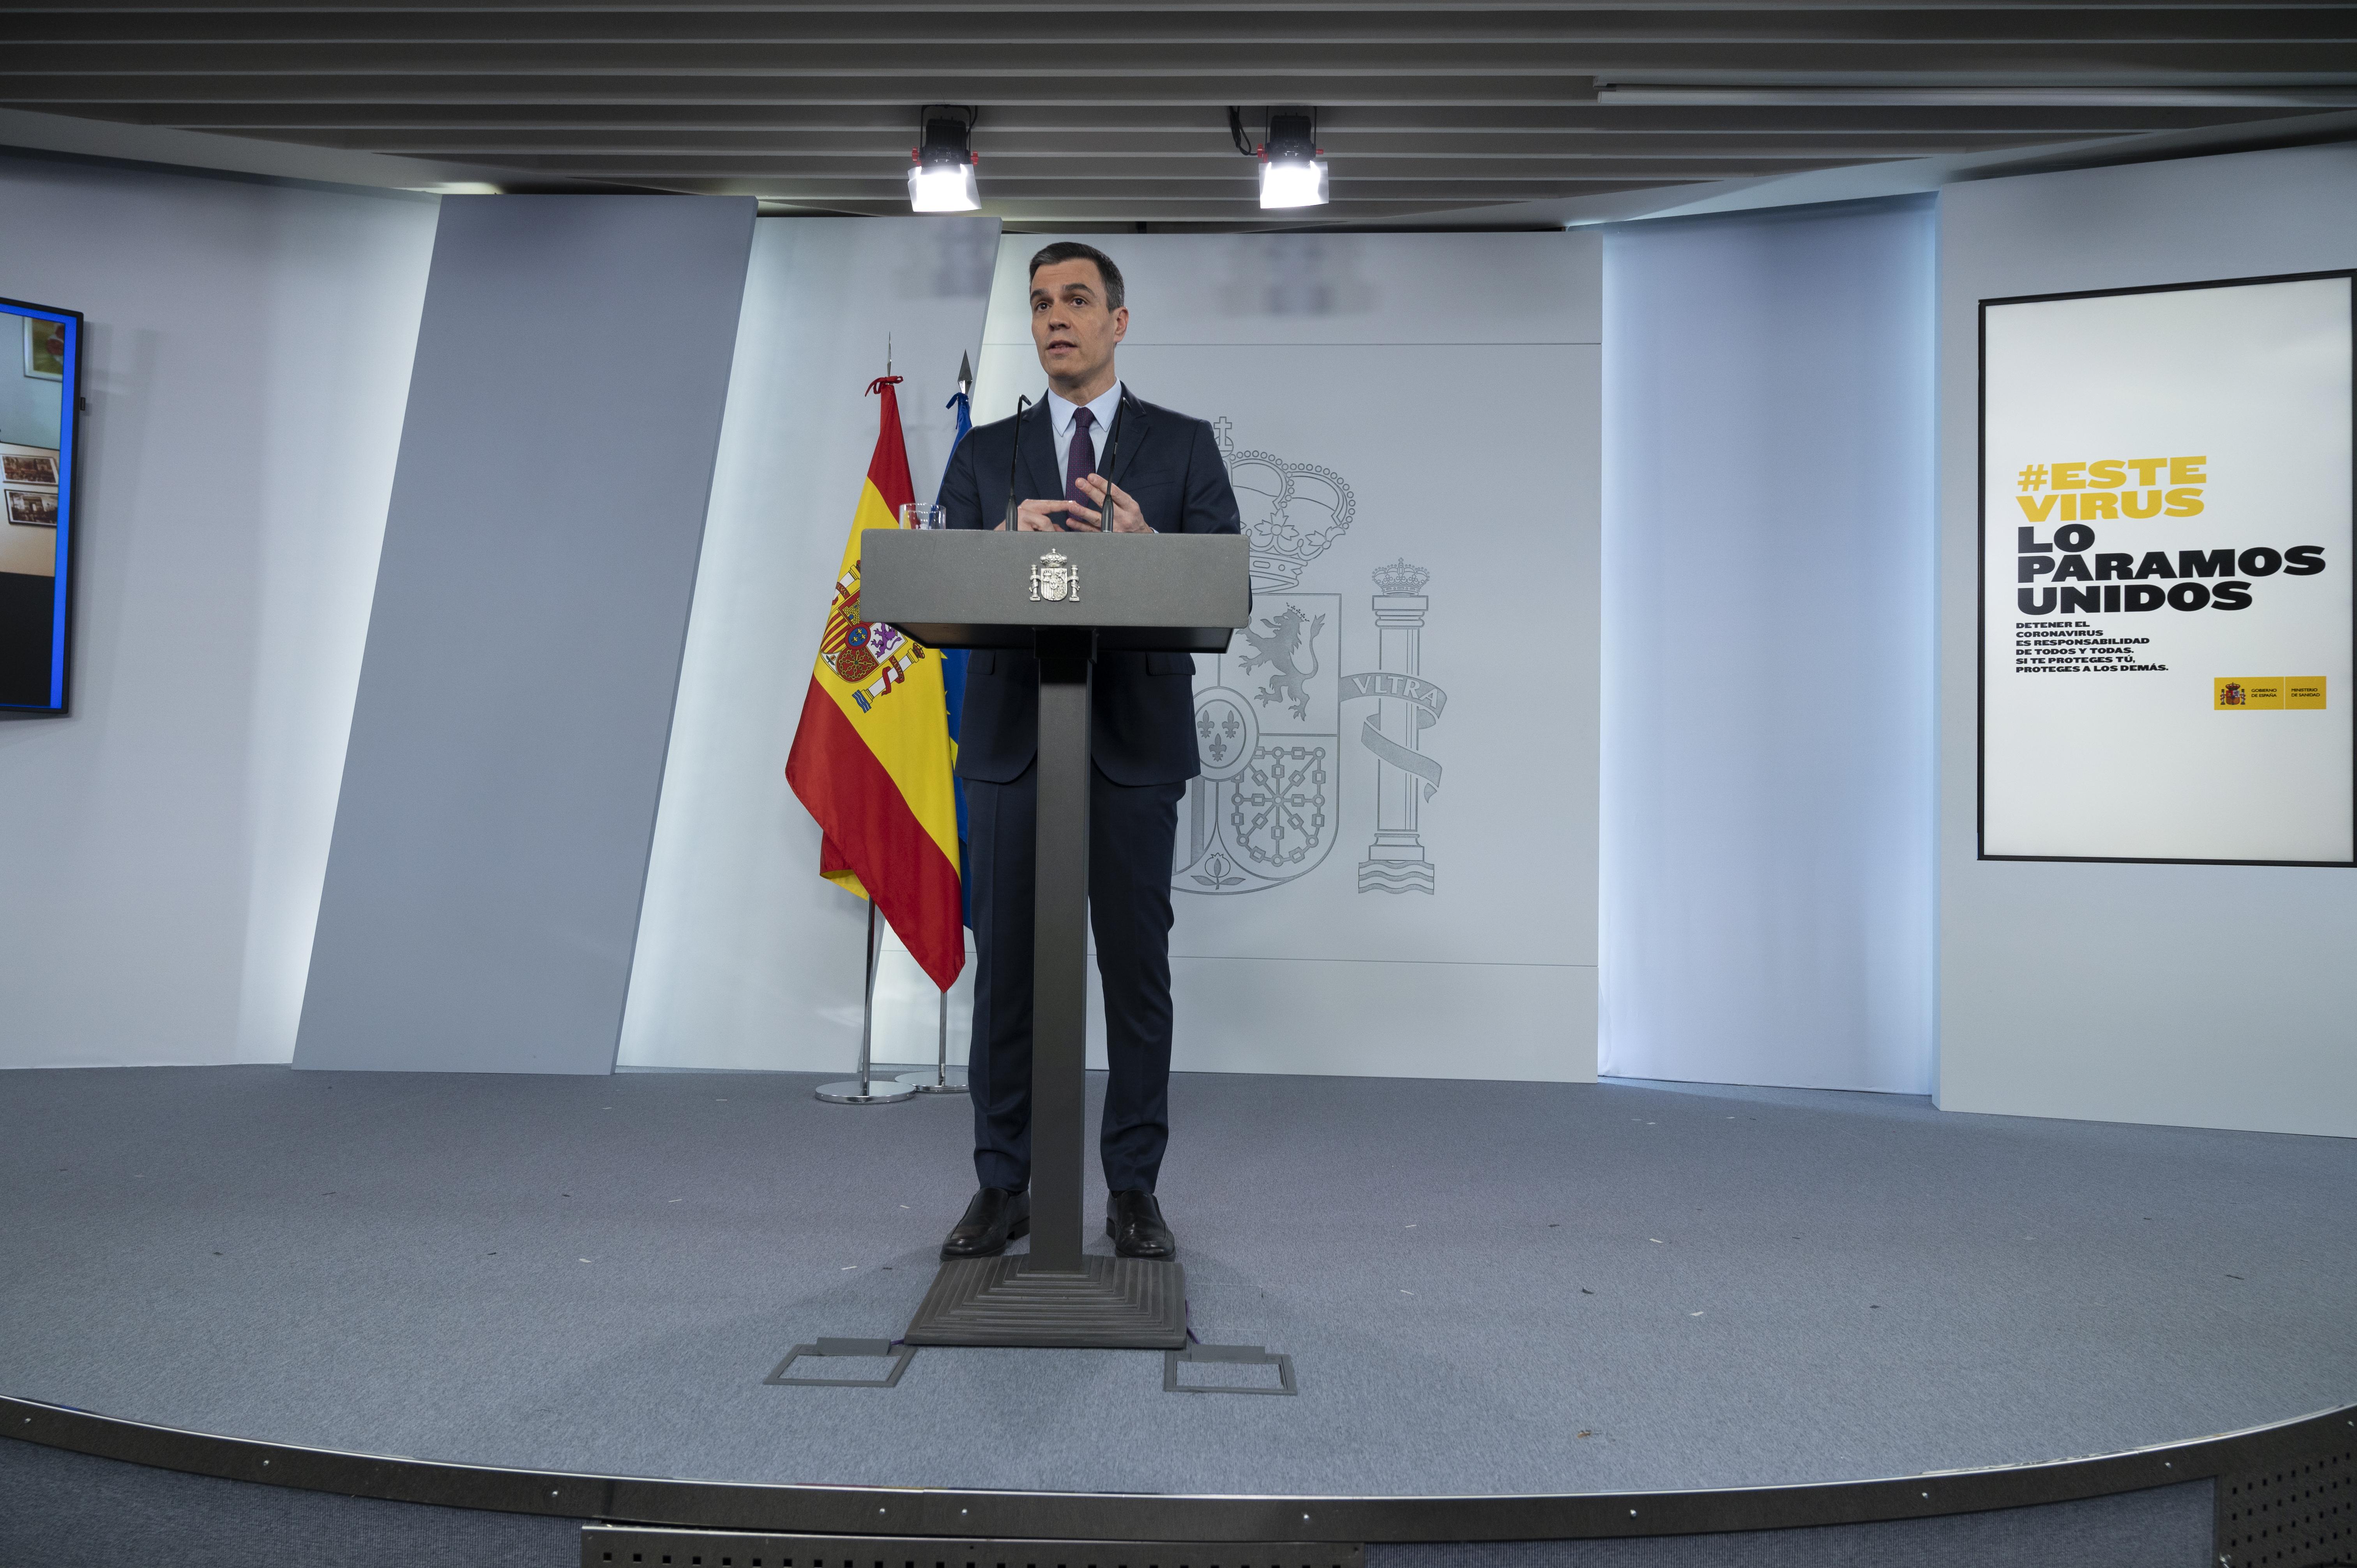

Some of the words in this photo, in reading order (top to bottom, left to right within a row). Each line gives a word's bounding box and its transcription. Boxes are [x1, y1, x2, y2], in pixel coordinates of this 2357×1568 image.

[2018, 456, 2206, 491] #ESTE
[2016, 487, 2204, 522] VIRUS
[2018, 524, 2095, 553] LO
[2018, 545, 2326, 583] PARAMOS
[2017, 581, 2253, 615] UNIDOS
[2016, 630, 2103, 638] CORONAVIRUS
[2034, 637, 2150, 646] RESPONSABILIDAD
[2116, 655, 2136, 663] TÚ,
[2120, 663, 2169, 671] DEMÁS.
[1352, 676, 1438, 709] VLTRA
